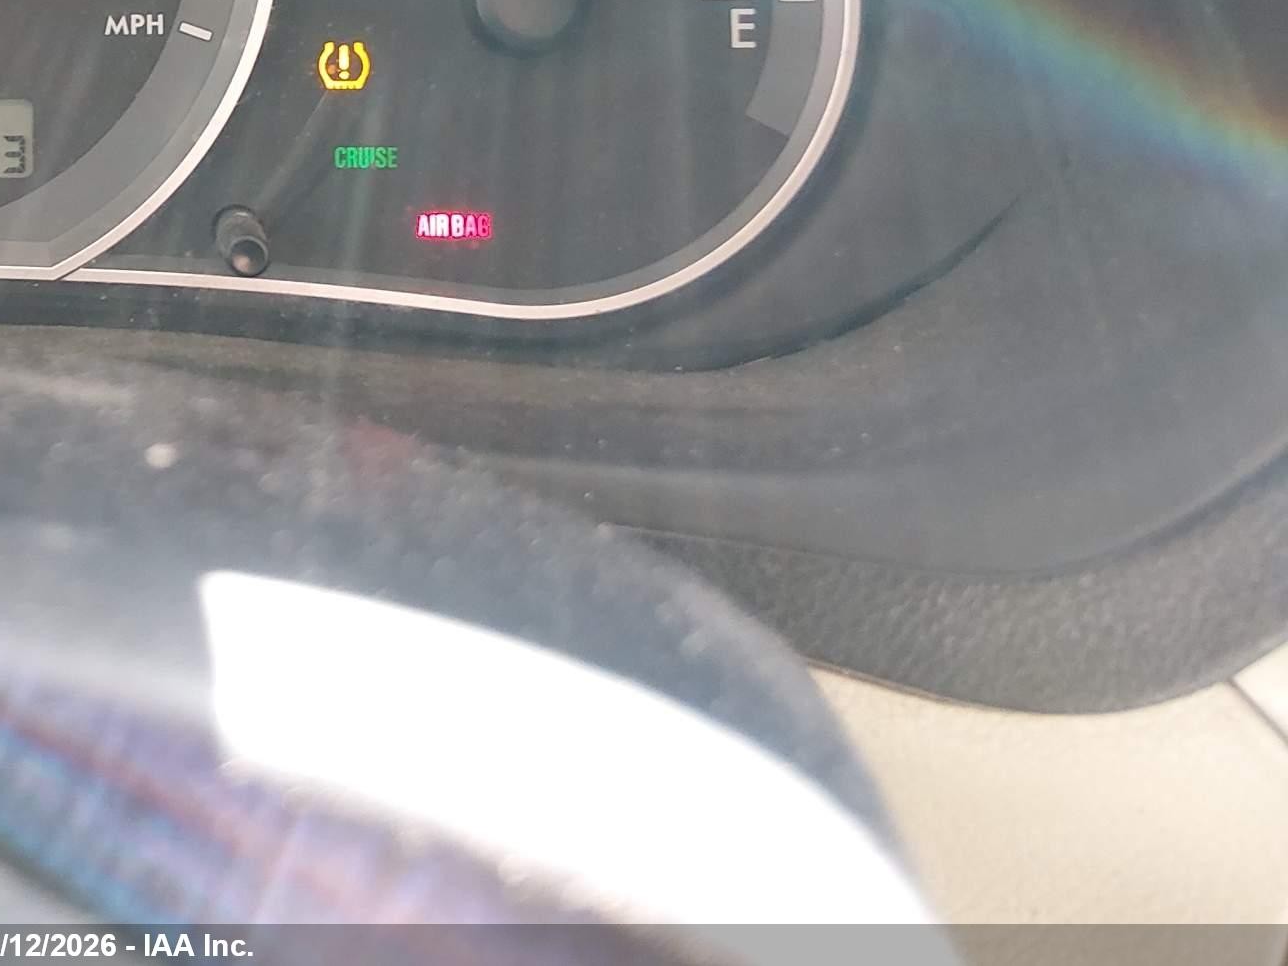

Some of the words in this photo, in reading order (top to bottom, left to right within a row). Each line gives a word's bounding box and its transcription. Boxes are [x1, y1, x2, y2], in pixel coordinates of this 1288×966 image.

[105, 14, 163, 35] MPH
[731, 9, 756, 48] E
[334, 146, 398, 169] CRUISE
